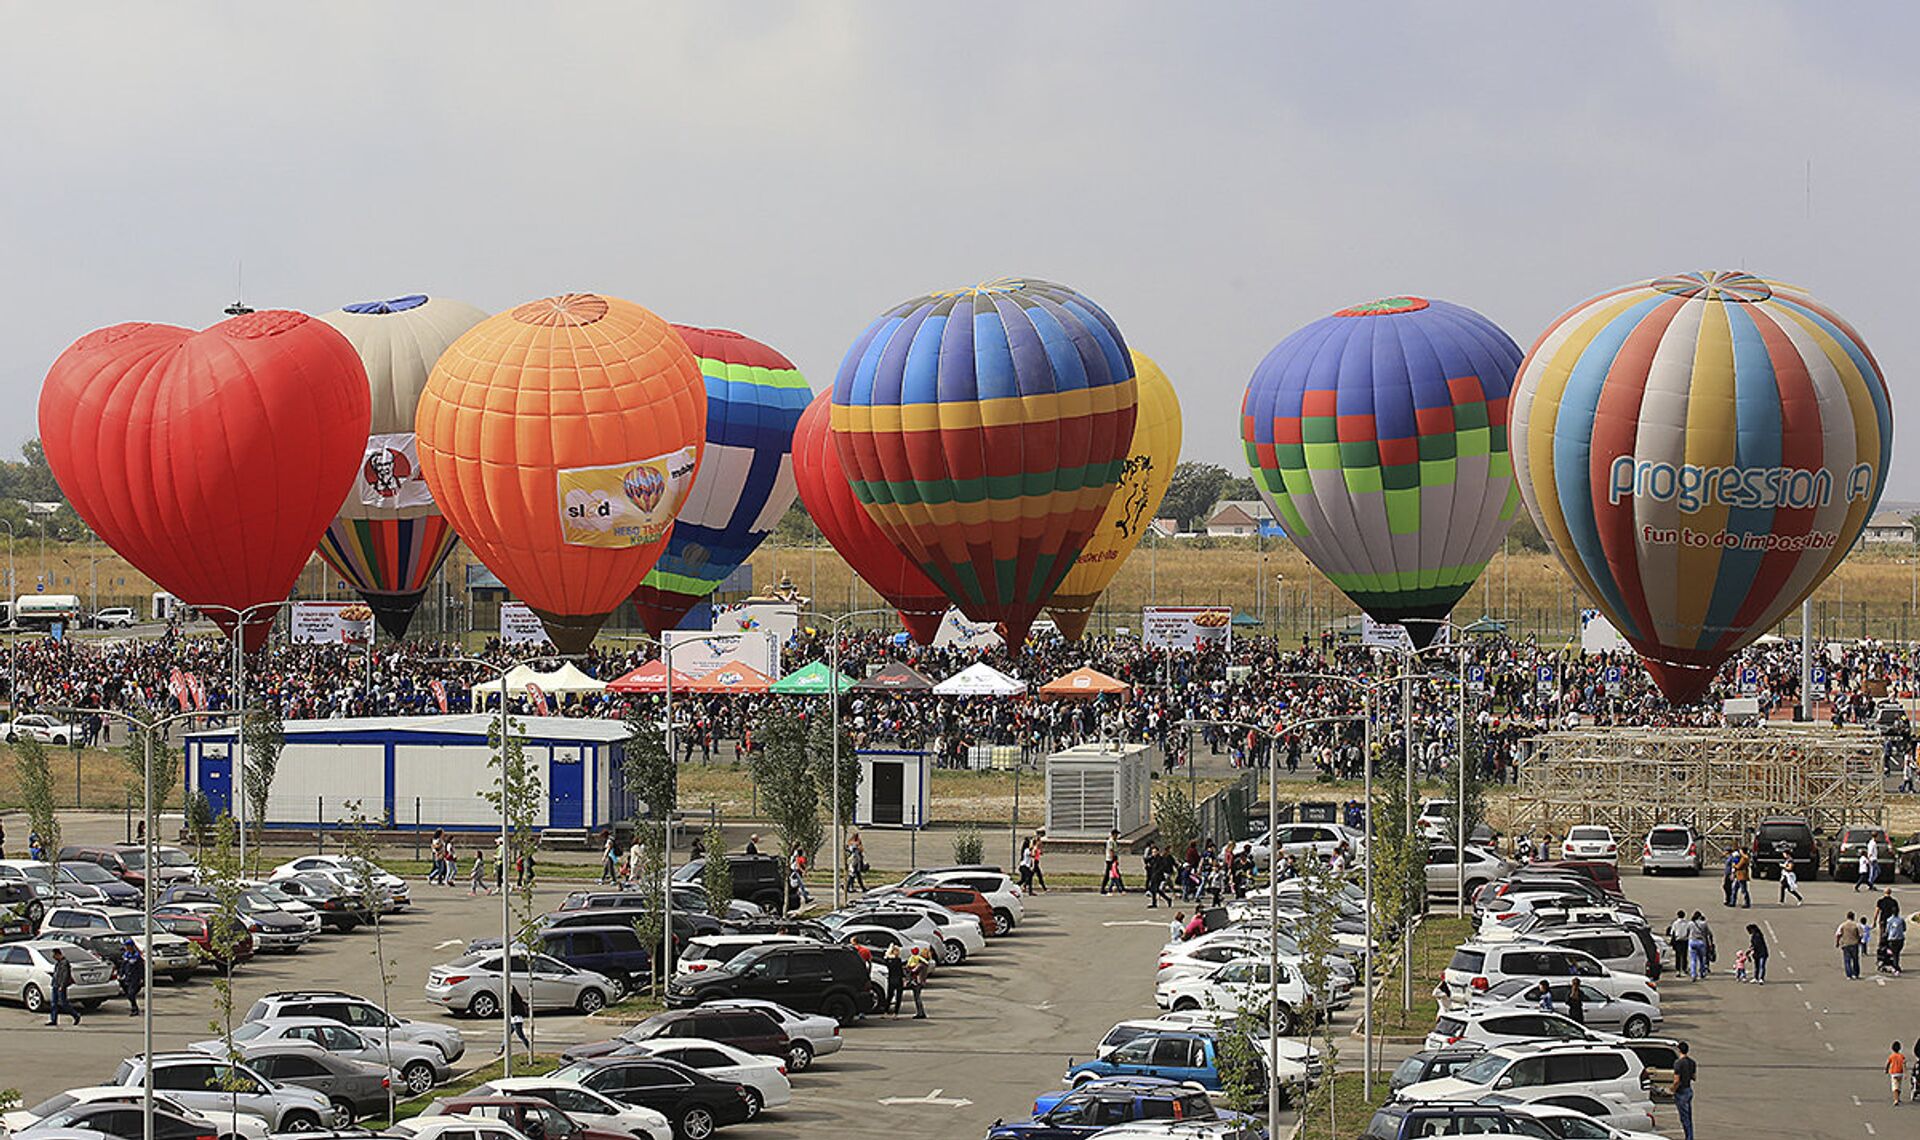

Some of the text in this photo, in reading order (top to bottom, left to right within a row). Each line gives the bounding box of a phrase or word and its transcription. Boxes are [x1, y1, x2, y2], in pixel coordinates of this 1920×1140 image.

[1643, 524, 1838, 551] fun to do impossible
